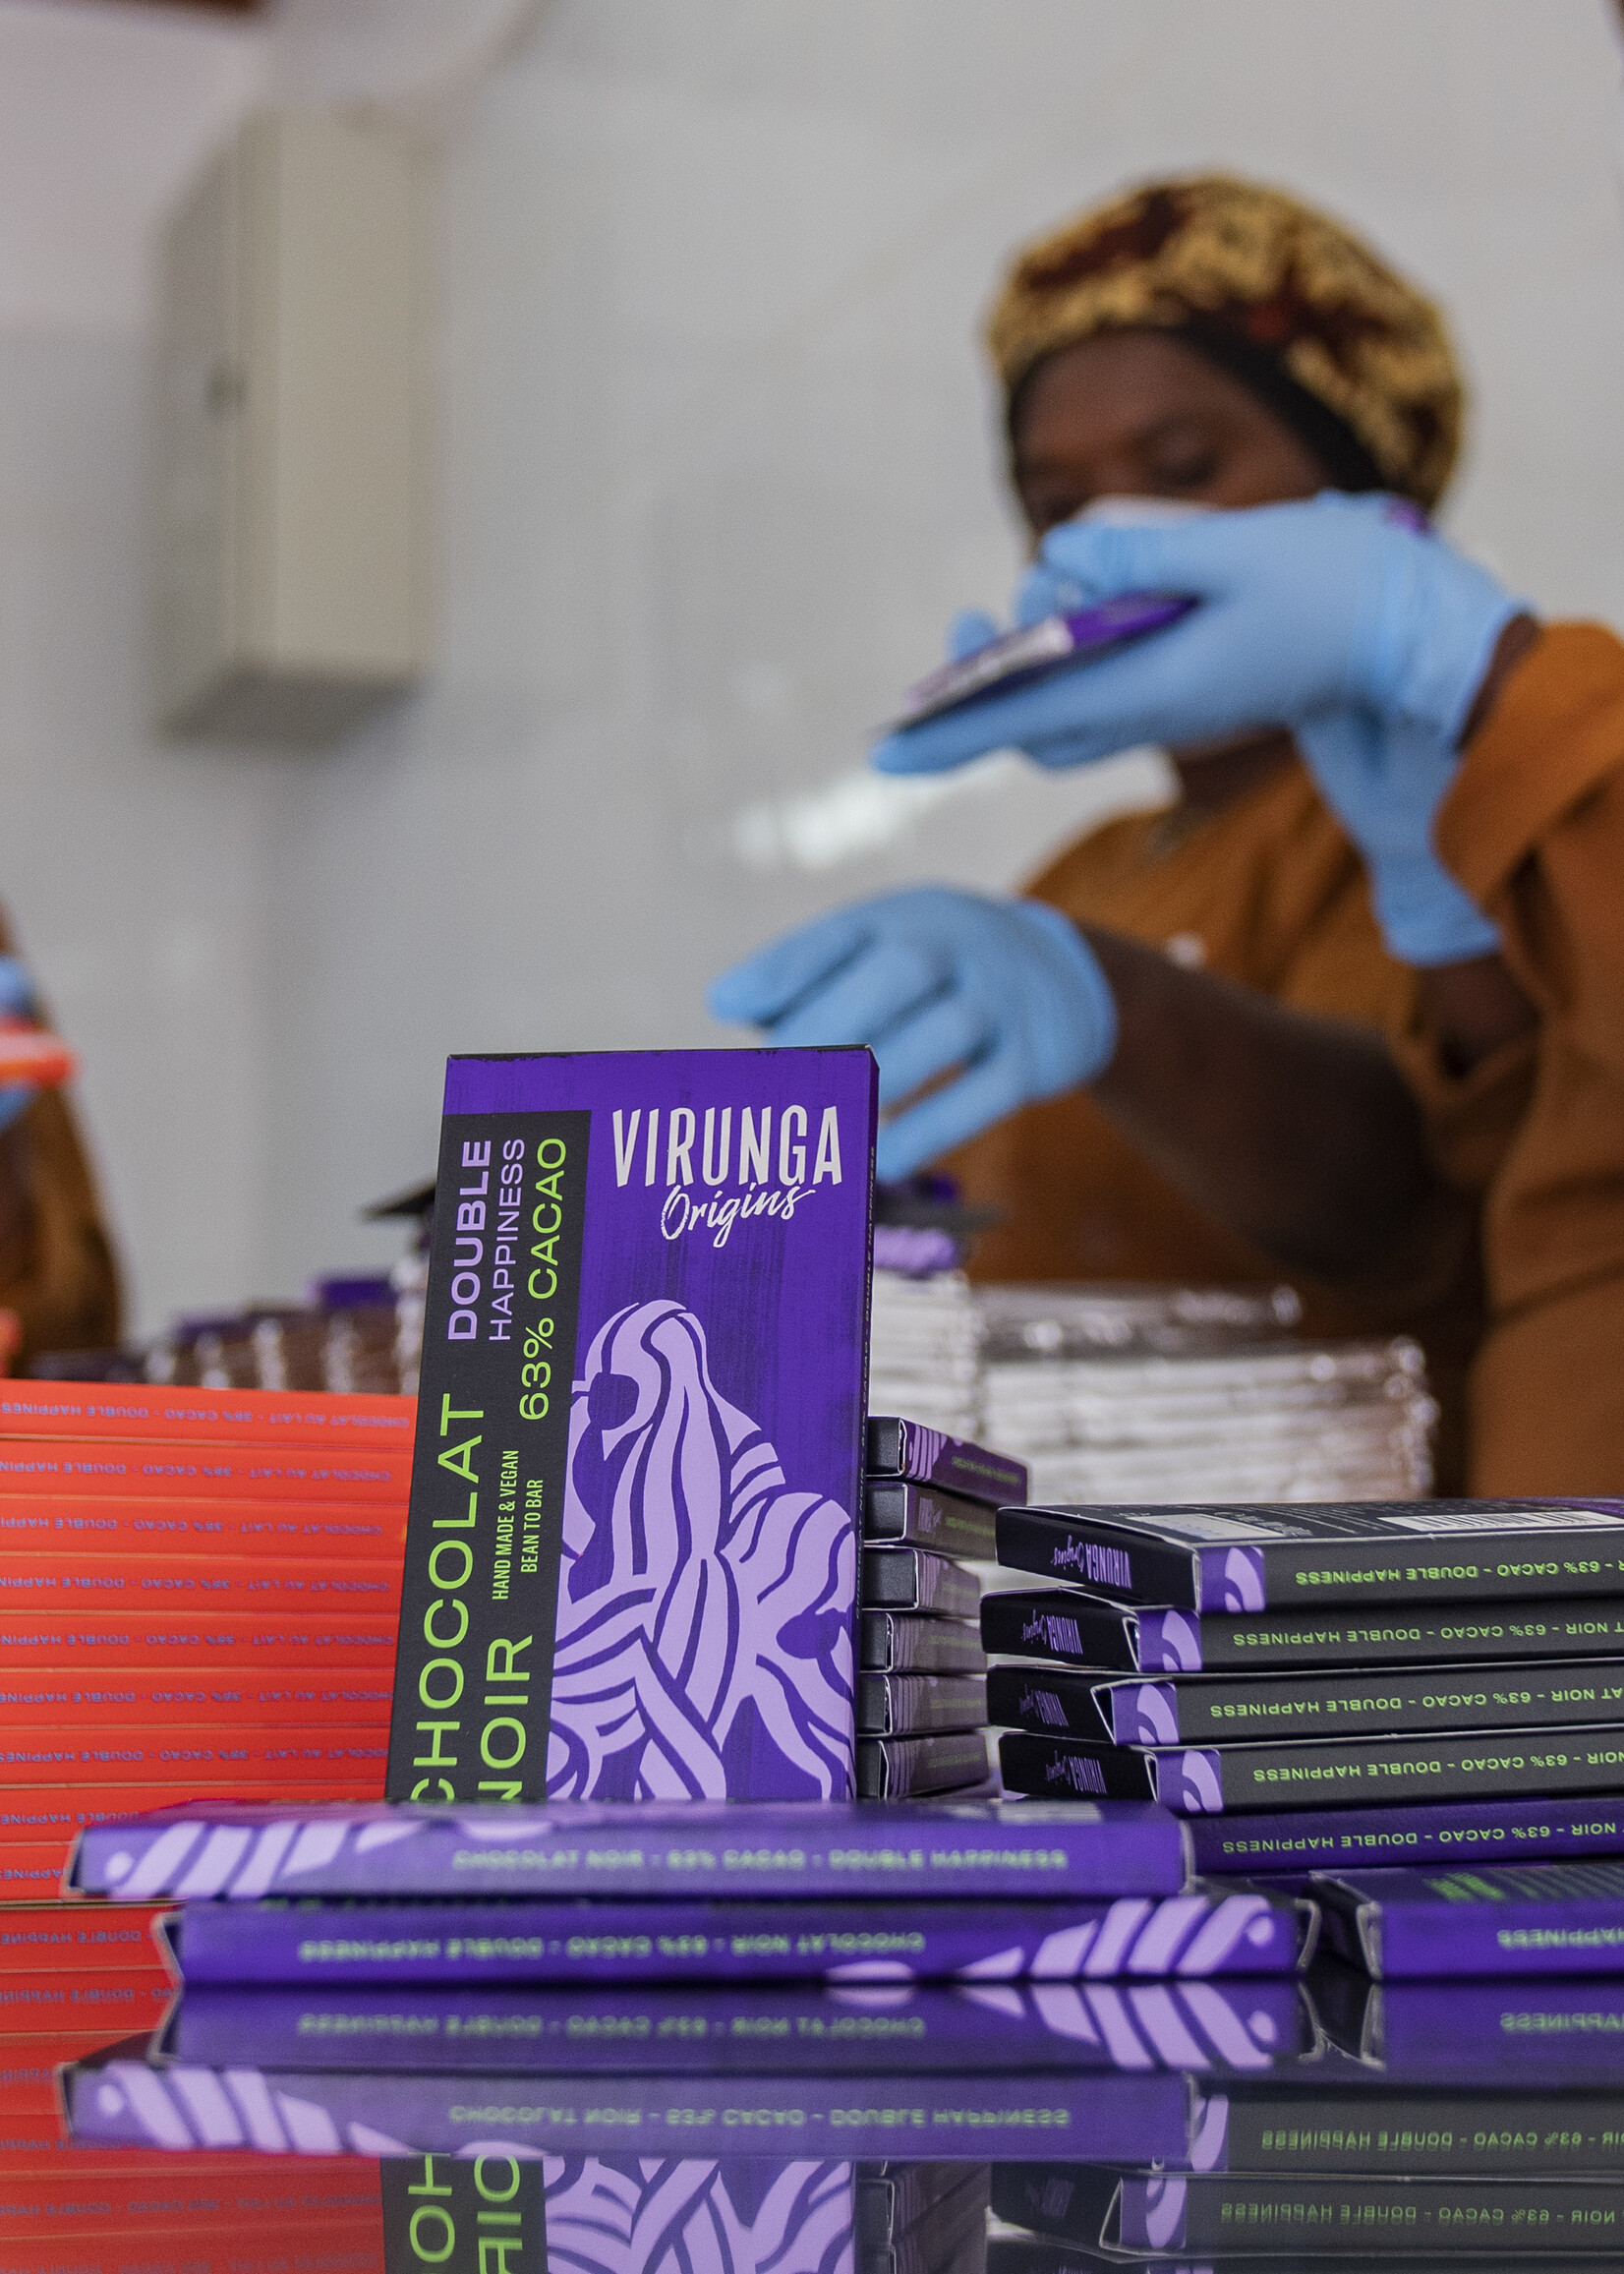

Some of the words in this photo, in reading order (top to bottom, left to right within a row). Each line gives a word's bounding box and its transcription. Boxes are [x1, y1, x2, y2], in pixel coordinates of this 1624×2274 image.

[612, 1104, 842, 1188] VIRUNGA
[527, 1137, 567, 1299] CACAO
[661, 1183, 817, 1249] Origins
[447, 1140, 492, 1340] DOUBLE
[489, 1138, 525, 1341] HAPPINESS
[519, 1317, 554, 1420] 63%
[499, 1450, 520, 1497] VEGAN
[524, 1480, 544, 1509] BAR
[498, 1500, 516, 1512] &
[523, 1511, 542, 1532] TO
[494, 1516, 514, 1555] MADE
[520, 1535, 540, 1573] BEAN
[1051, 1535, 1085, 1573] Origins
[1084, 1544, 1132, 1589] VIRUNGA
[1406, 1565, 1479, 1581] DOUBLE
[1496, 1562, 1560, 1577] CACAO
[1563, 1560, 1600, 1574] 63%
[492, 1559, 512, 1600] HAND
[1295, 1569, 1402, 1586] HAPPINESS
[1046, 1615, 1083, 1655] VIRUNGA
[1347, 1628, 1421, 1643] DOUBLE
[1440, 1625, 1504, 1639] CACAO
[1509, 1623, 1546, 1636] 63%
[1565, 1622, 1608, 1635] NOIR
[1233, 1631, 1341, 1647] HAPPINESS
[1421, 1693, 1487, 1709] CACAO
[1492, 1691, 1532, 1705] 63%
[1551, 1689, 1595, 1702] NOIR
[1210, 1701, 1320, 1718] HAPPINESS
[1326, 1697, 1403, 1713] DOUBLE
[1367, 1760, 1442, 1777] DOUBLE
[1460, 1756, 1525, 1772] CACAO
[1530, 1754, 1568, 1768] 63%
[1252, 1765, 1362, 1782] HAPPINESS
[1438, 1827, 1506, 1843] CACAO
[1510, 1825, 1551, 1838] 63%
[1571, 1822, 1616, 1836] NOIR
[1222, 1837, 1334, 1854] HAPPINESS
[1341, 1832, 1419, 1847] DOUBLE
